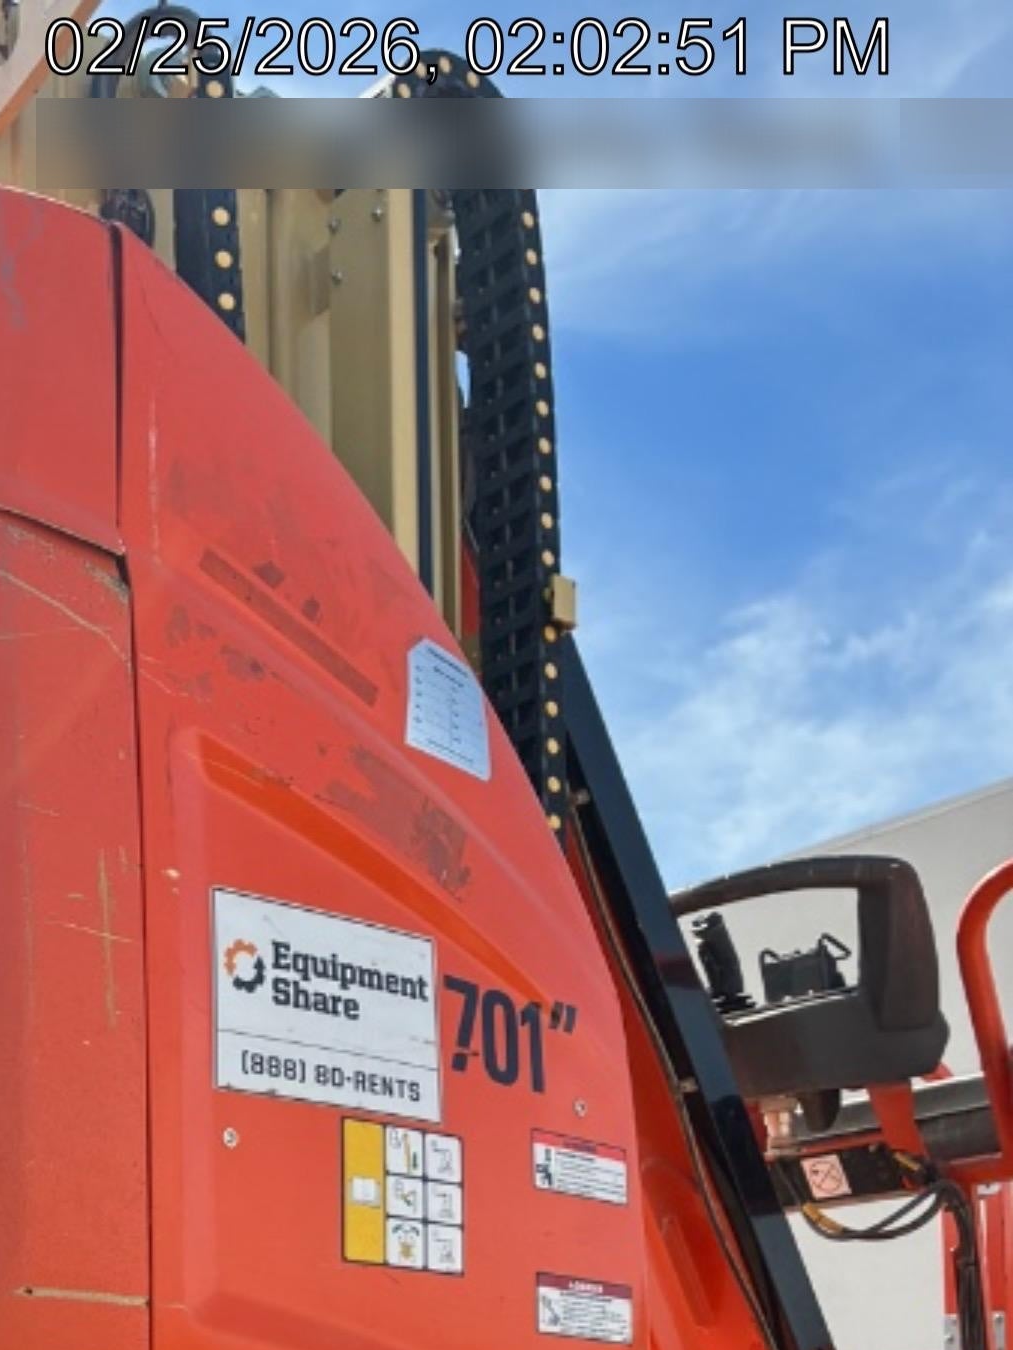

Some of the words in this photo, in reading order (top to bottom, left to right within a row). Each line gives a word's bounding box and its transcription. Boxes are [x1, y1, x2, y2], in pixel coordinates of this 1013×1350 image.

[271, 939, 429, 1002] Equipment
[271, 976, 360, 1021] Share
[241, 1049, 306, 1083] (888)
